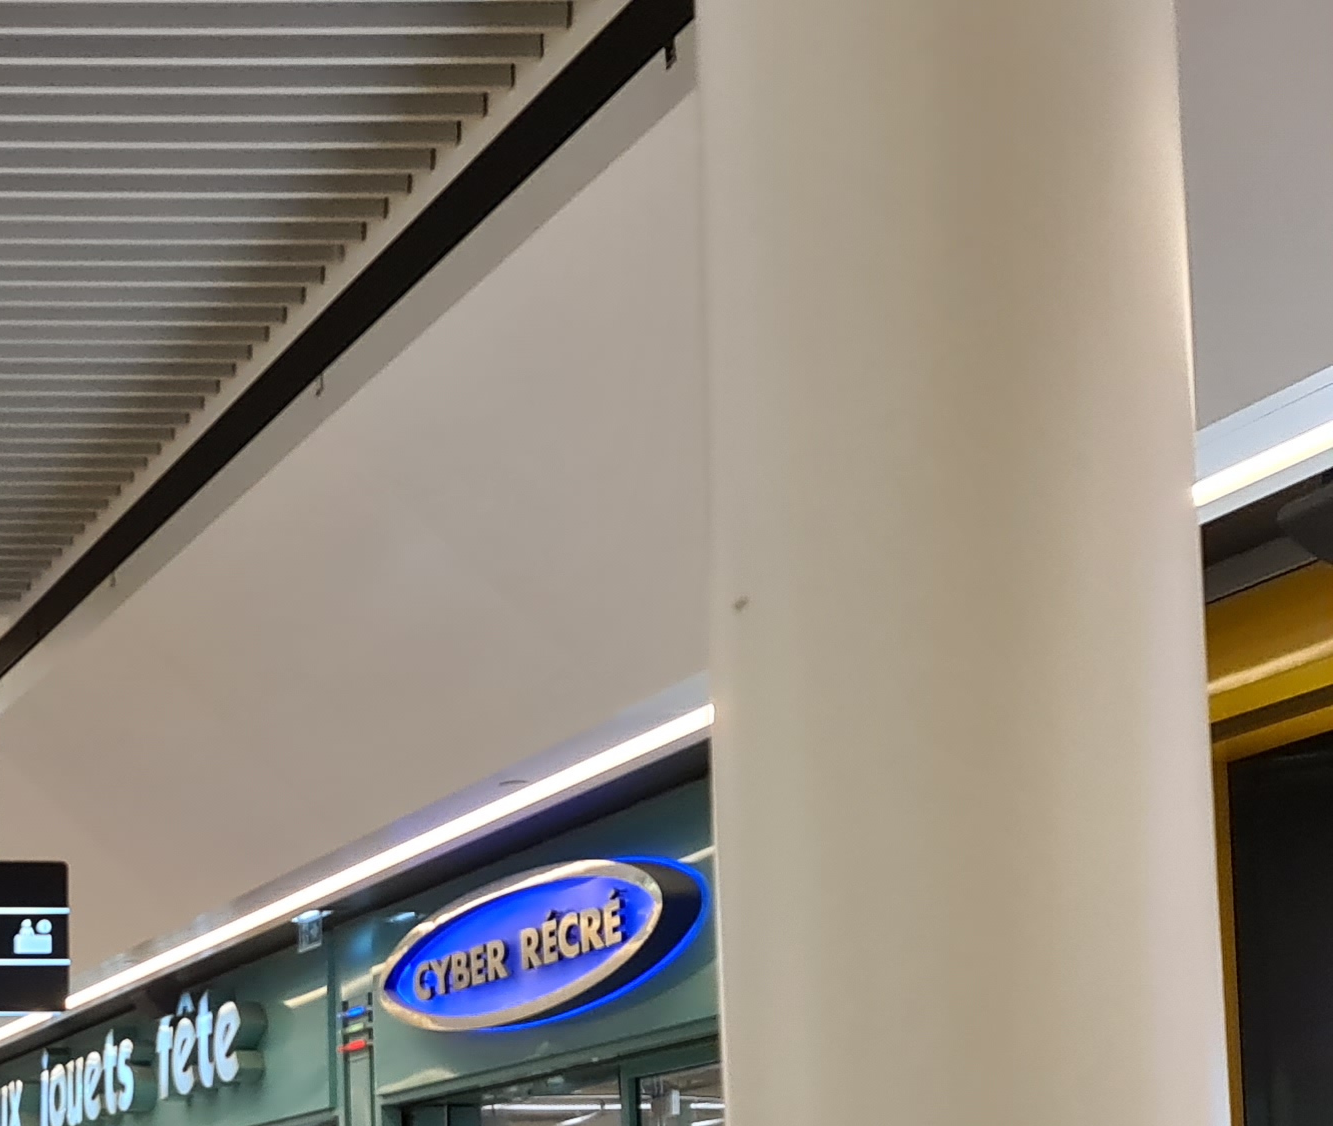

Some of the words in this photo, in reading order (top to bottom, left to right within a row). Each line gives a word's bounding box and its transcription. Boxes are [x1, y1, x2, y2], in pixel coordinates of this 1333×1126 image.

[414, 940, 510, 1000] CYBER
[519, 888, 624, 972] RÉCRÉ
[156, 990, 241, 1100] fête
